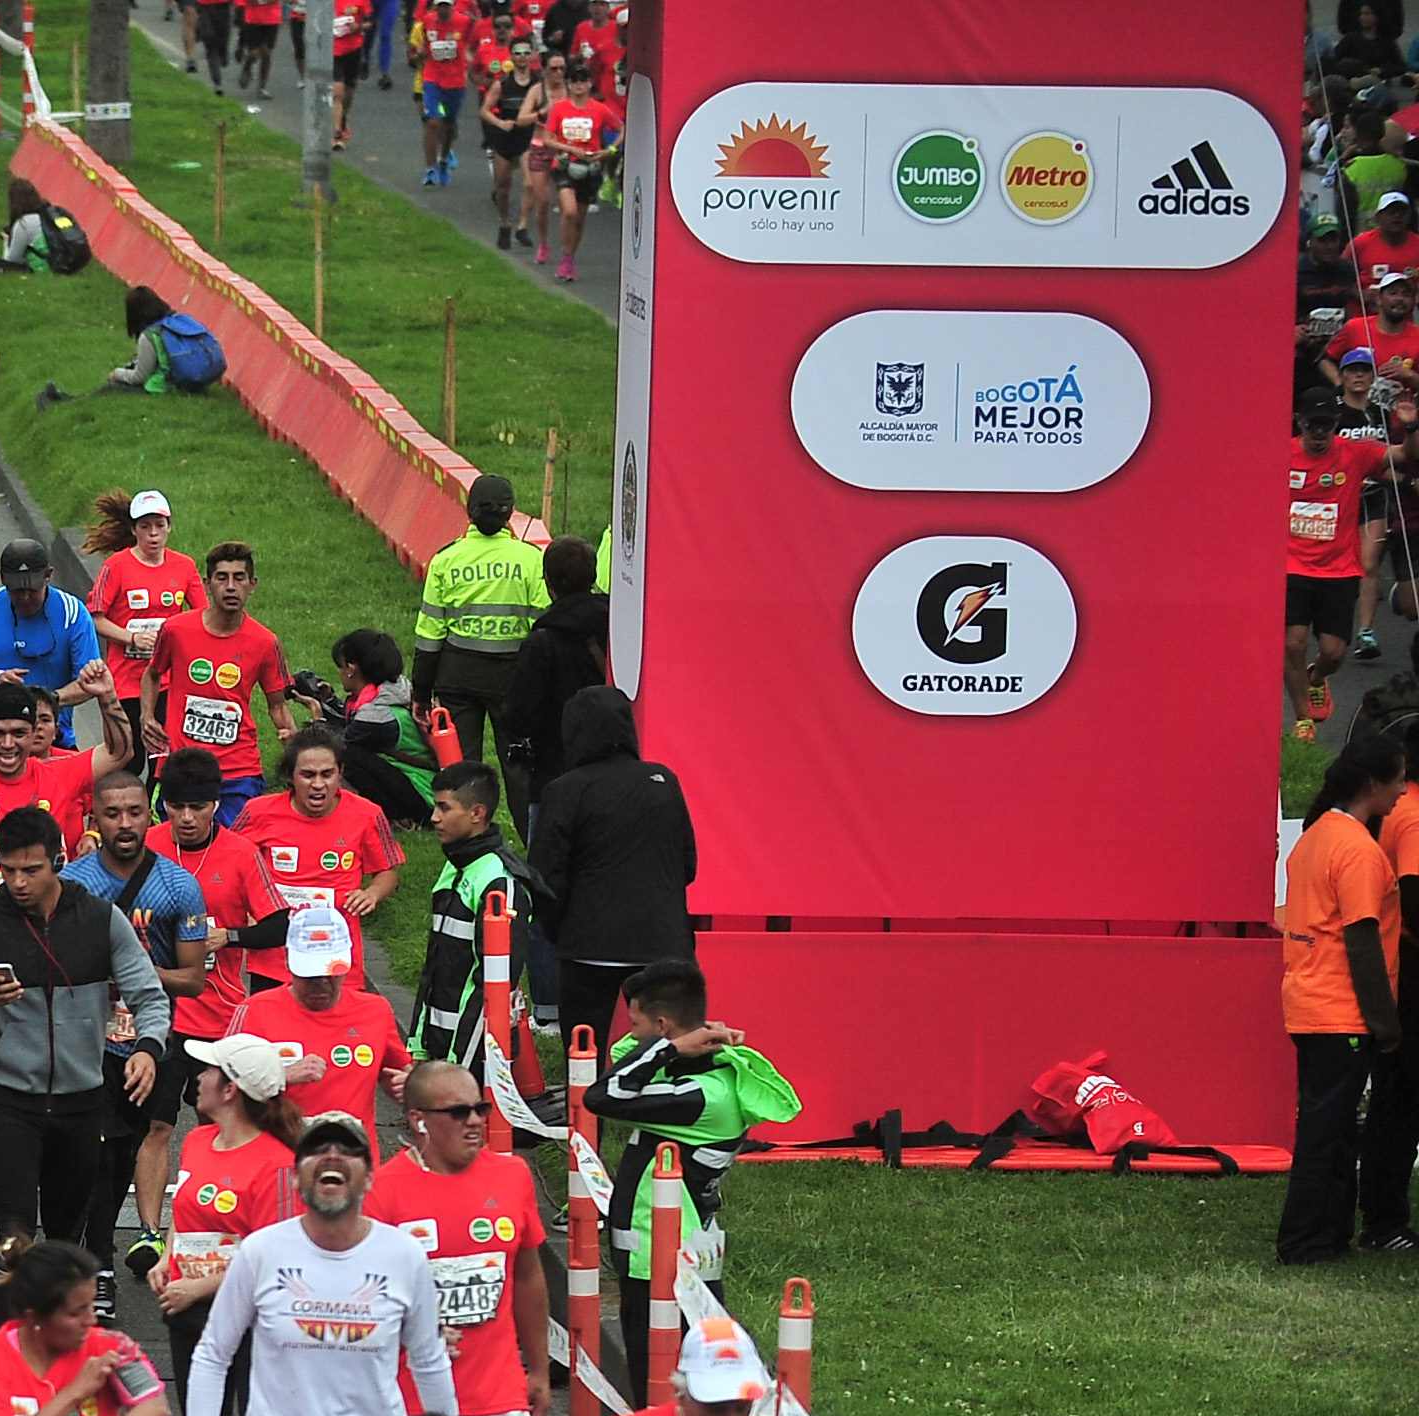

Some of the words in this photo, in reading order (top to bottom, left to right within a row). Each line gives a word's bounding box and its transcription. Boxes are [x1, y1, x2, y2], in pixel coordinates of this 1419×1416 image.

[898, 164, 979, 188] JUMBO
[1005, 165, 1088, 189] Metro
[702, 185, 842, 218] porvenir
[912, 194, 964, 206] cencosud
[1023, 199, 1069, 210] cencosud
[1137, 187, 1251, 218] adidas
[750, 217, 779, 232] sólo
[781, 217, 805, 234] hay
[808, 220, 835, 232] uno
[975, 364, 1084, 404] BOGOTÁ
[858, 420, 905, 431] ALCALDÍA
[906, 422, 939, 432] MAYOR
[974, 405, 1084, 429] MEJOR
[862, 433, 875, 441] DE
[876, 431, 916, 442] BOGOTÁ
[973, 431, 1019, 444] PARA
[1023, 431, 1083, 445] TODOS
[449, 563, 524, 584] POLICIA
[901, 674, 1024, 694] GATORADE
[182, 713, 239, 740] 32463
